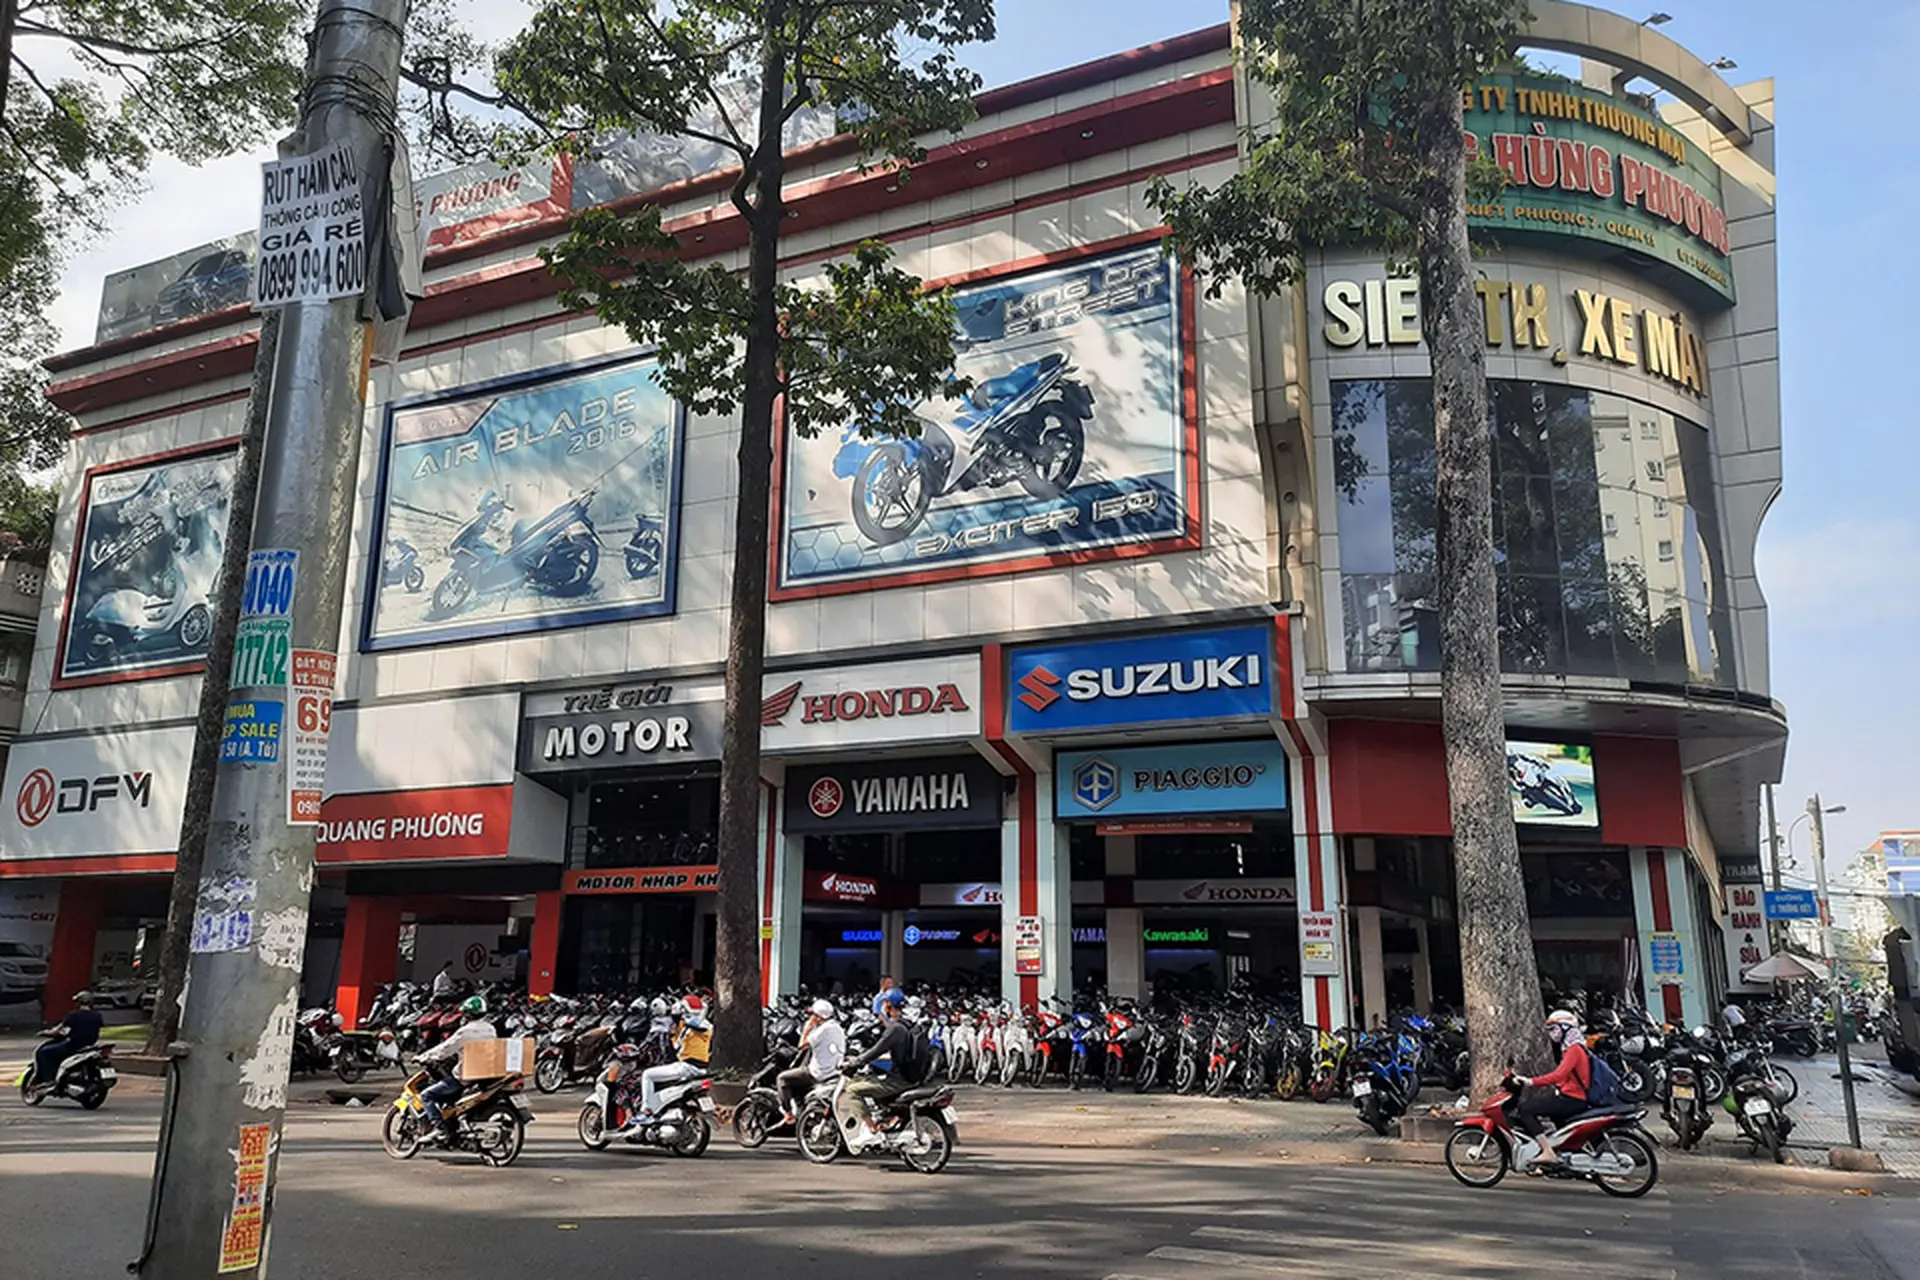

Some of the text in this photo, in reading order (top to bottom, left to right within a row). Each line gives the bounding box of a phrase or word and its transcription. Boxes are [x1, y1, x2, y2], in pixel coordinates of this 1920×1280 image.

[1480, 86, 1508, 112] TY
[1516, 88, 1579, 120] TNHH
[1493, 121, 1614, 198] HÙNG
[262, 225, 313, 251] GIÁ
[258, 239, 364, 302] 0899 994 600
[1323, 261, 1421, 346] SIÊ
[1574, 287, 1637, 366] XE
[411, 387, 637, 480] AIR BLADE
[567, 416, 638, 456] 2016
[916, 507, 1080, 557] EXCITER
[1067, 654, 1260, 701] SUZUKI
[801, 683, 970, 725] HONDA
[239, 722, 279, 738] SALE
[544, 716, 691, 760] MOTOR
[57, 771, 153, 814] DFM
[851, 772, 970, 814] YAMAHA
[1133, 765, 1256, 792] PIAGGIO
[316, 811, 485, 843] QUANG PHƯƠNG
[576, 875, 636, 890] MOTOR
[641, 871, 688, 888] NHẬP
[836, 880, 877, 895] HONDA
[1208, 887, 1294, 901] HONDA
[1071, 928, 1108, 943] YAMA
[1142, 927, 1209, 942] Kawasaki
